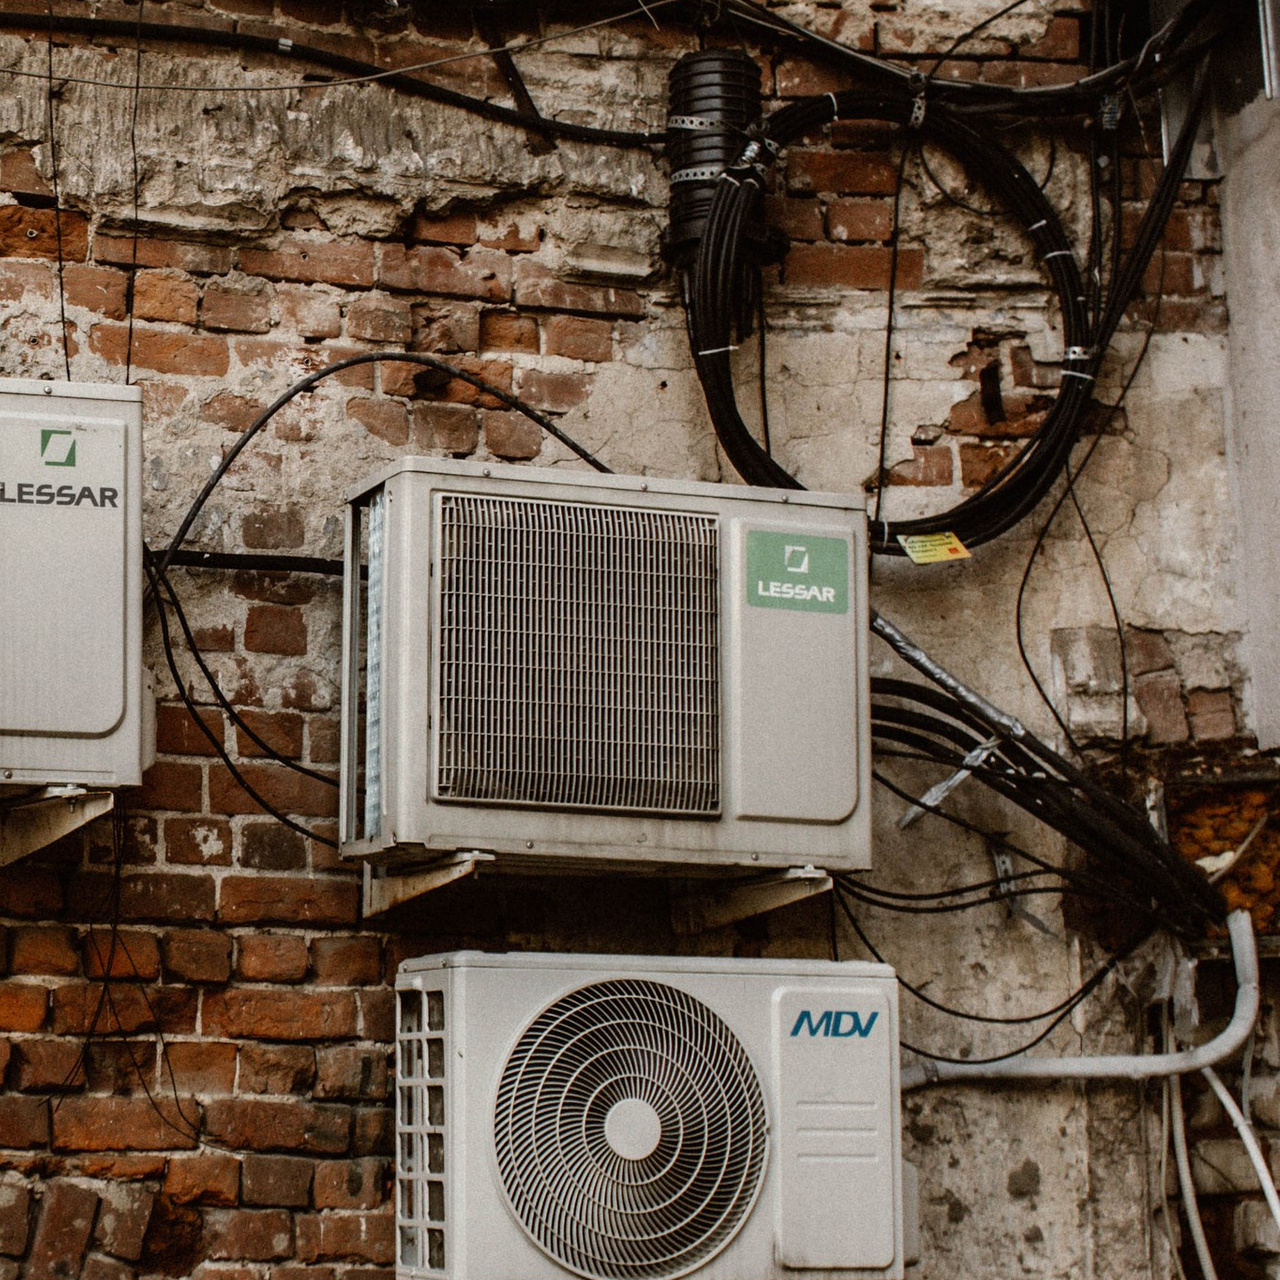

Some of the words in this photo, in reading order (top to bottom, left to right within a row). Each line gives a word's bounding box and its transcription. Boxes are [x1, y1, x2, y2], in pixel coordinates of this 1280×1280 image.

[0, 482, 119, 508] LESSAR
[758, 581, 835, 602] LESSAR
[790, 1010, 879, 1038] MDV
